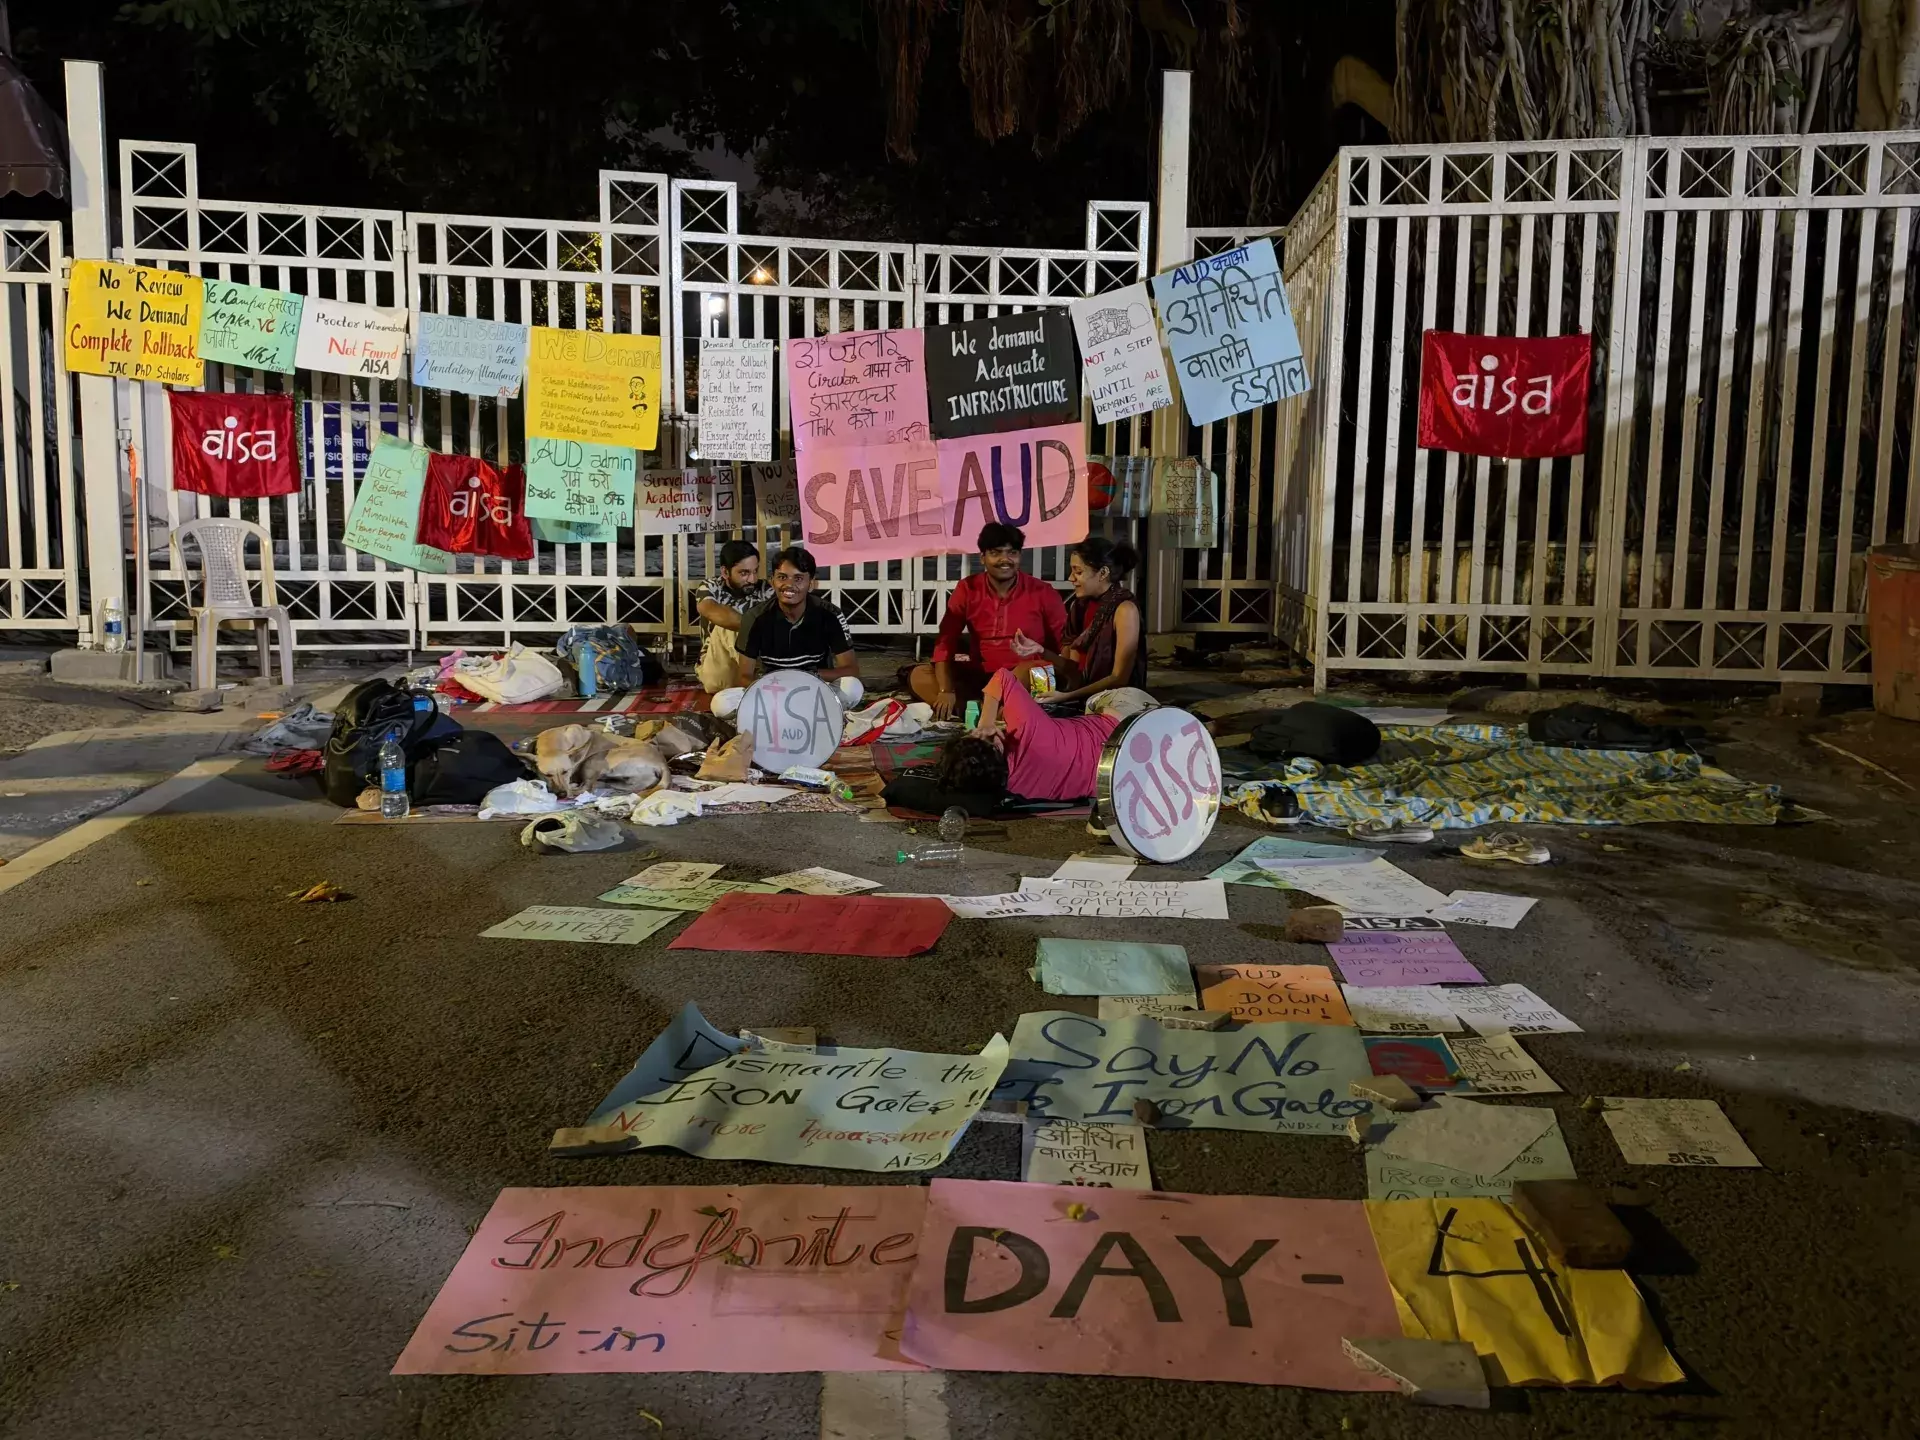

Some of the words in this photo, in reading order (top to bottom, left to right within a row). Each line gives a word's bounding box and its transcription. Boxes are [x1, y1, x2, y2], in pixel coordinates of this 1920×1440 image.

[99, 268, 121, 290] No
[1171, 260, 1210, 289] AUD
[220, 288, 266, 313] Campus
[107, 300, 132, 321] We
[139, 305, 188, 326] Demand
[316, 312, 360, 329] Proctor
[257, 318, 276, 333] VC
[280, 321, 296, 337] Ki
[951, 329, 976, 357] We
[988, 316, 1045, 351] demand
[70, 323, 132, 362] Complete
[328, 336, 357, 357] Not
[362, 341, 399, 360] Found
[538, 330, 578, 361] We
[703, 339, 734, 350] Demand
[742, 339, 771, 350] Charter
[1084, 351, 1106, 367] NOT
[1113, 347, 1121, 357] A
[1126, 336, 1153, 353] STEP
[710, 358, 735, 369] Complete
[741, 355, 768, 370] Rollback
[1179, 333, 1255, 379] कालीन
[108, 361, 127, 375] JAC
[135, 363, 152, 377] PhD
[157, 366, 190, 382] Scholars
[359, 358, 390, 376] AISA
[417, 359, 476, 384] Mandatory
[717, 369, 731, 380] 31st
[808, 368, 860, 389] Circular
[863, 362, 892, 379] वापस
[894, 356, 915, 374] लो
[975, 348, 1046, 389] Adequate
[1104, 361, 1128, 378] BACK
[709, 382, 723, 394] End
[729, 381, 740, 393] the
[747, 381, 763, 394] Iron
[1092, 377, 1136, 401] UNTIL
[1144, 369, 1160, 382] ALL
[1452, 354, 1553, 416] aisa
[560, 388, 594, 404] Drinking
[723, 395, 747, 405] regime
[947, 379, 1068, 421] INFRASTRUCTURE
[1096, 393, 1137, 414] DEMANDS
[1146, 385, 1163, 397] ARE
[708, 406, 744, 418] Reinstate
[848, 408, 879, 430] करो
[201, 416, 277, 464] aisa
[706, 430, 730, 441] Ensure
[531, 439, 583, 468] AUD
[590, 450, 632, 471] admin
[378, 466, 392, 480] VC
[643, 473, 717, 488] Surveillance
[757, 465, 782, 483] YOU
[528, 484, 556, 499] Basic
[645, 490, 704, 505] Academic
[766, 493, 795, 505] GIVE
[804, 458, 943, 545] SAVE
[953, 439, 1076, 537] AUD
[450, 476, 512, 527] aisa
[656, 504, 713, 519] Autonomy
[678, 524, 691, 533] JAC
[710, 522, 737, 531] Scholars
[357, 535, 369, 549] Dry
[753, 684, 836, 756] AISA
[782, 728, 803, 741] AUD
[1115, 720, 1219, 839] aisa
[1071, 880, 1104, 889] NO
[1077, 889, 1189, 897] DEMAND
[1000, 892, 1043, 906] AUD
[1056, 896, 1183, 907] COMPLETE
[503, 920, 635, 935] MATTERS
[1343, 918, 1424, 930] AISA
[1218, 968, 1282, 980] AUD
[1401, 966, 1440, 976] AUD
[1257, 981, 1302, 991] VC
[1240, 992, 1330, 1005] DOWN
[1231, 1006, 1332, 1020] DOWN!
[675, 1030, 906, 1080] Dismantle
[941, 1064, 986, 1083] the
[1028, 1017, 1218, 1089] Say
[1226, 1032, 1334, 1077] No
[635, 1077, 803, 1106] IRON
[608, 1111, 656, 1133] No
[686, 1115, 766, 1136] more
[798, 1117, 966, 1148] harassmen
[1034, 1146, 1097, 1162] कालीन
[1668, 1152, 1719, 1164] aisa
[491, 1206, 919, 1297] Indefinite
[1426, 1207, 1573, 1337] 4
